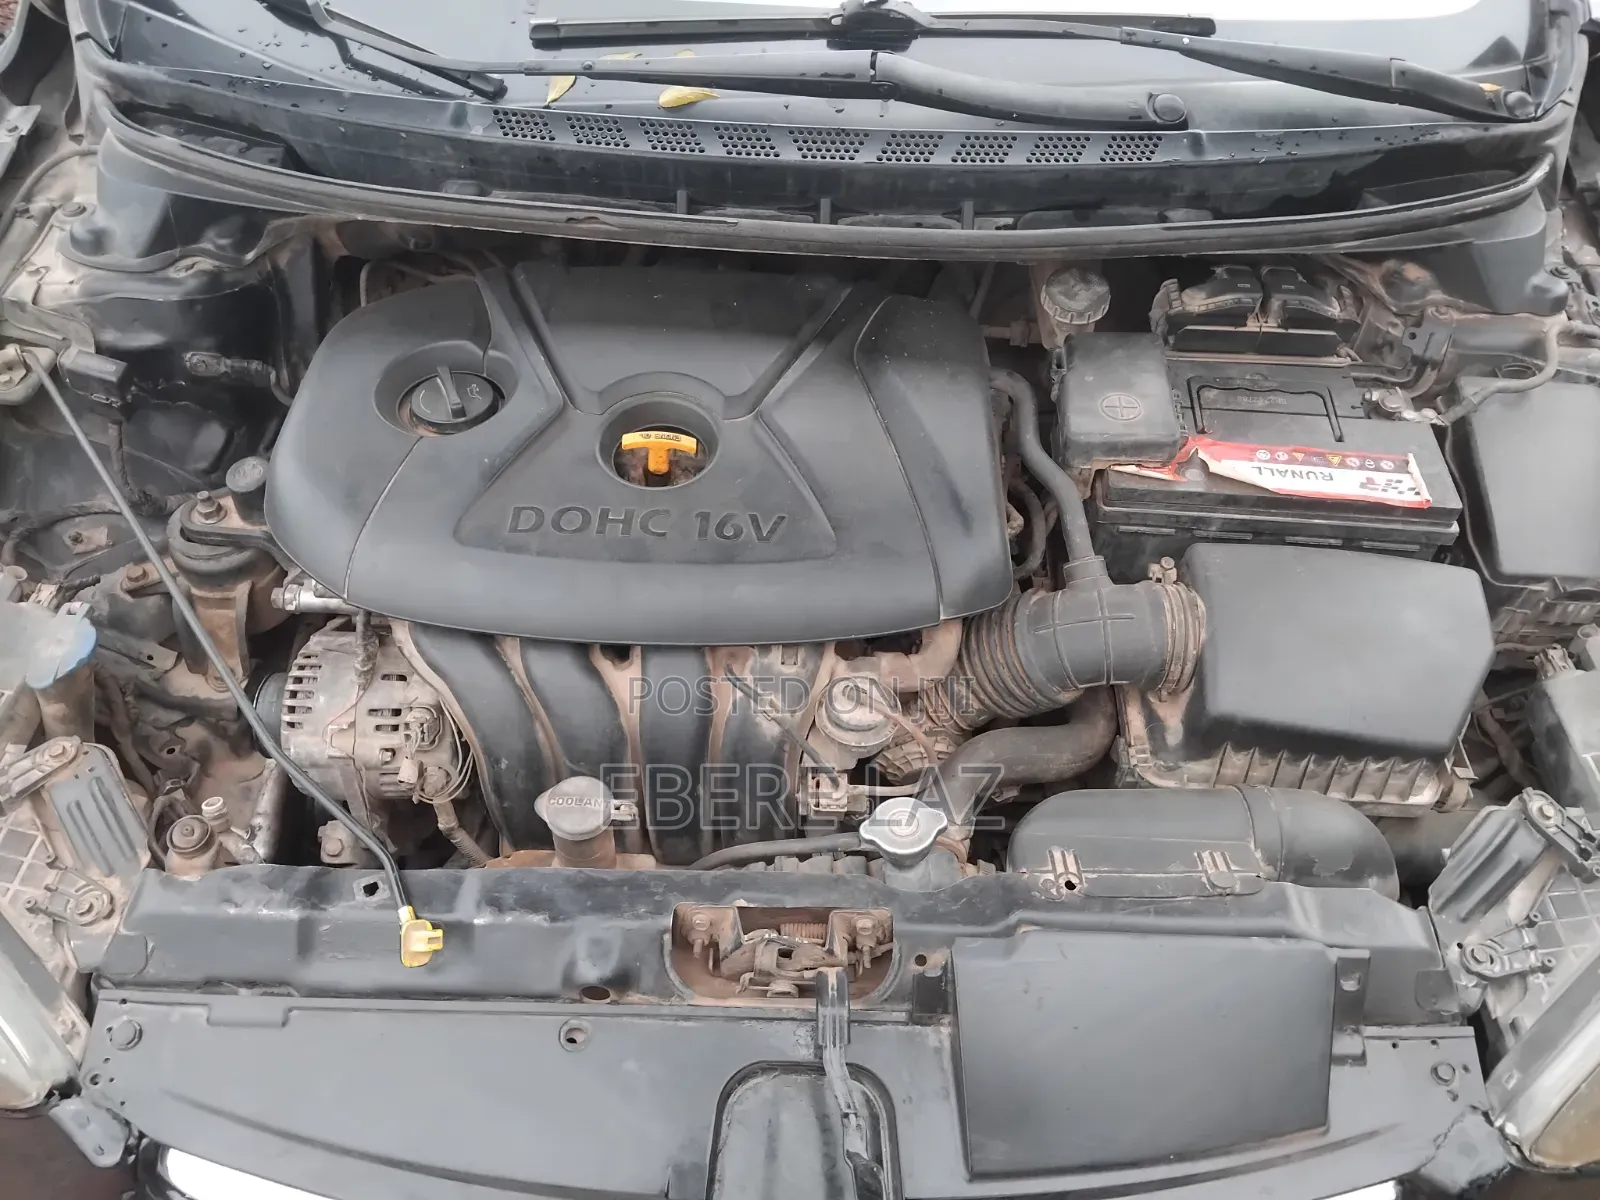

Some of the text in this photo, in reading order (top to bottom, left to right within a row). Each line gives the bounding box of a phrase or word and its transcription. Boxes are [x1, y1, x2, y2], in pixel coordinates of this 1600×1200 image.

[1251, 465, 1334, 482] RUNALL
[507, 505, 788, 544] DOHC 16V
